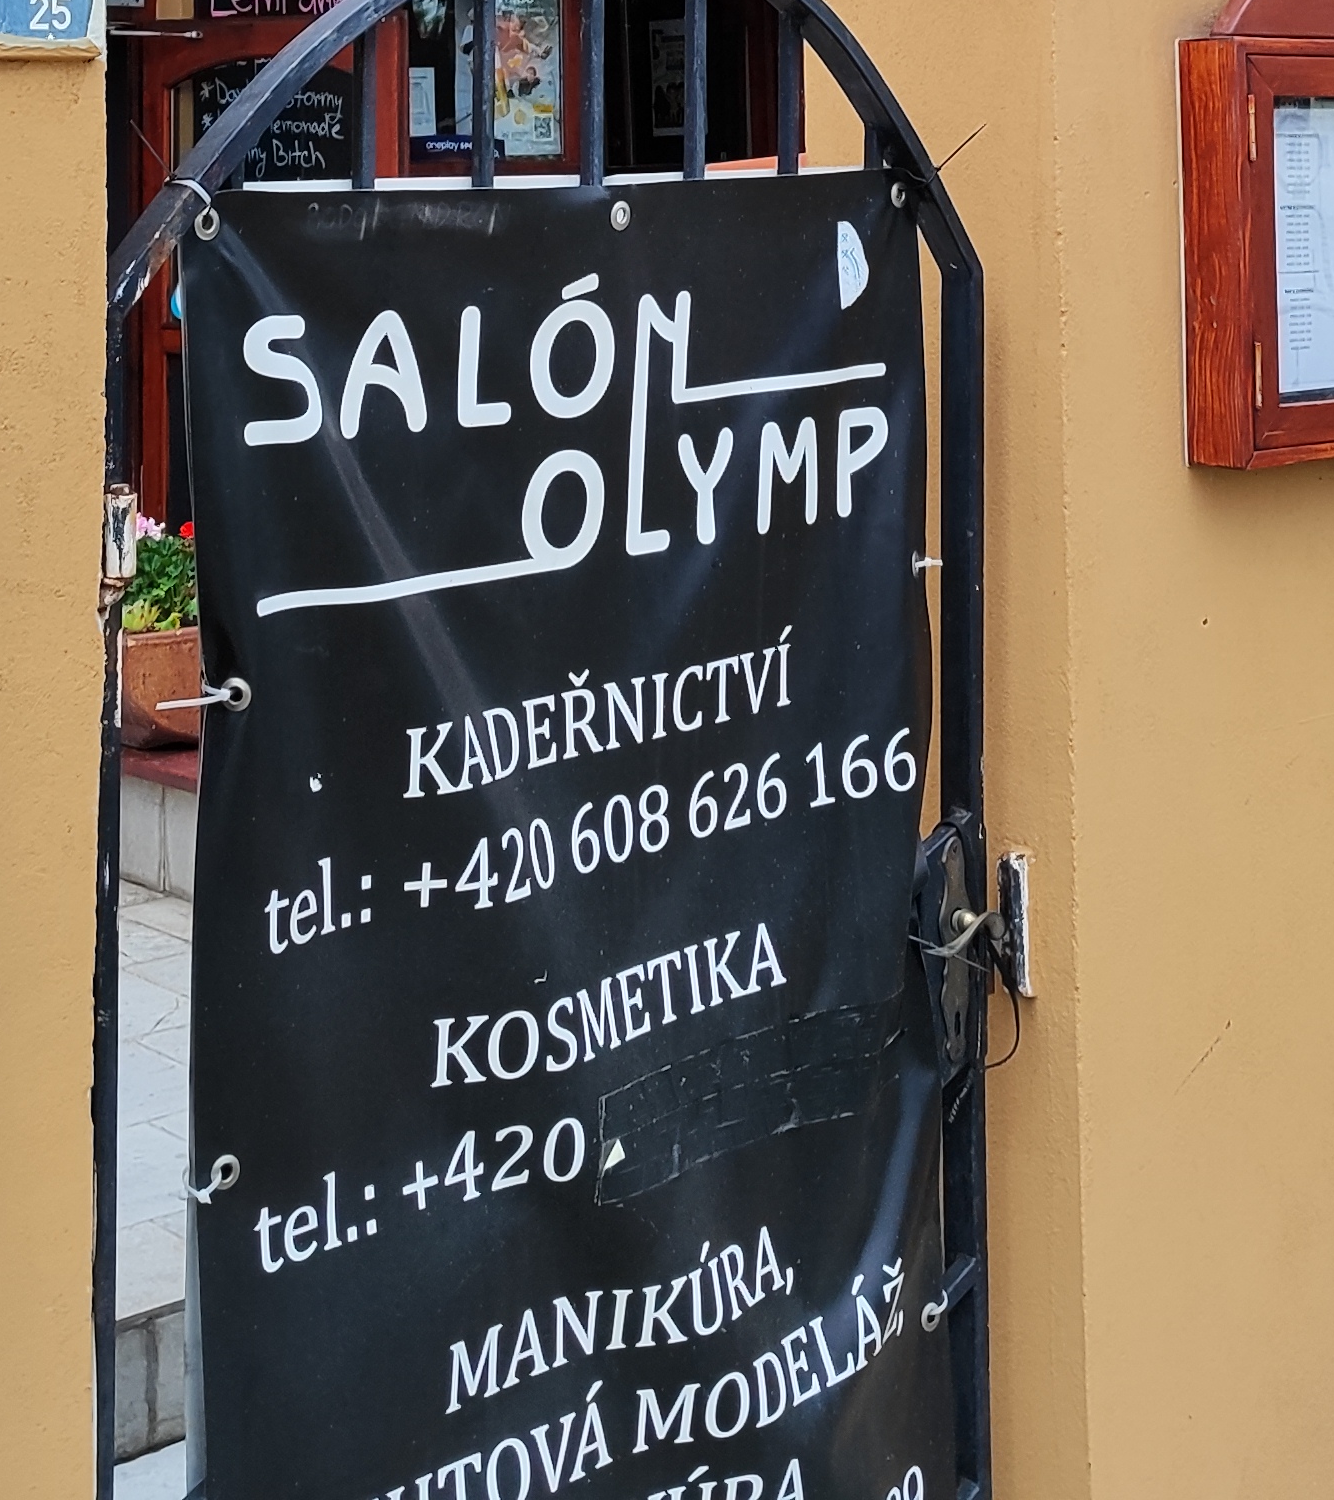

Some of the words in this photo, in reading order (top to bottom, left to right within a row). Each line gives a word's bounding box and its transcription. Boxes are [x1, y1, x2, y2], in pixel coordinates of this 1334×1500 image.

[244, 273, 693, 447] SALÓN
[521, 407, 889, 568] OLYMP
[403, 625, 793, 799] KADEŘNICTVÍ
[265, 858, 373, 955] tel.:
[403, 819, 555, 911] +420
[571, 784, 670, 875] 608
[688, 753, 788, 840] 626
[805, 727, 917, 809] 166
[430, 922, 788, 1088] KOSMETIKA
[253, 1172, 378, 1274] tel.:
[402, 1117, 586, 1211] +420
[445, 1225, 795, 1415] MANIKÚRA,
